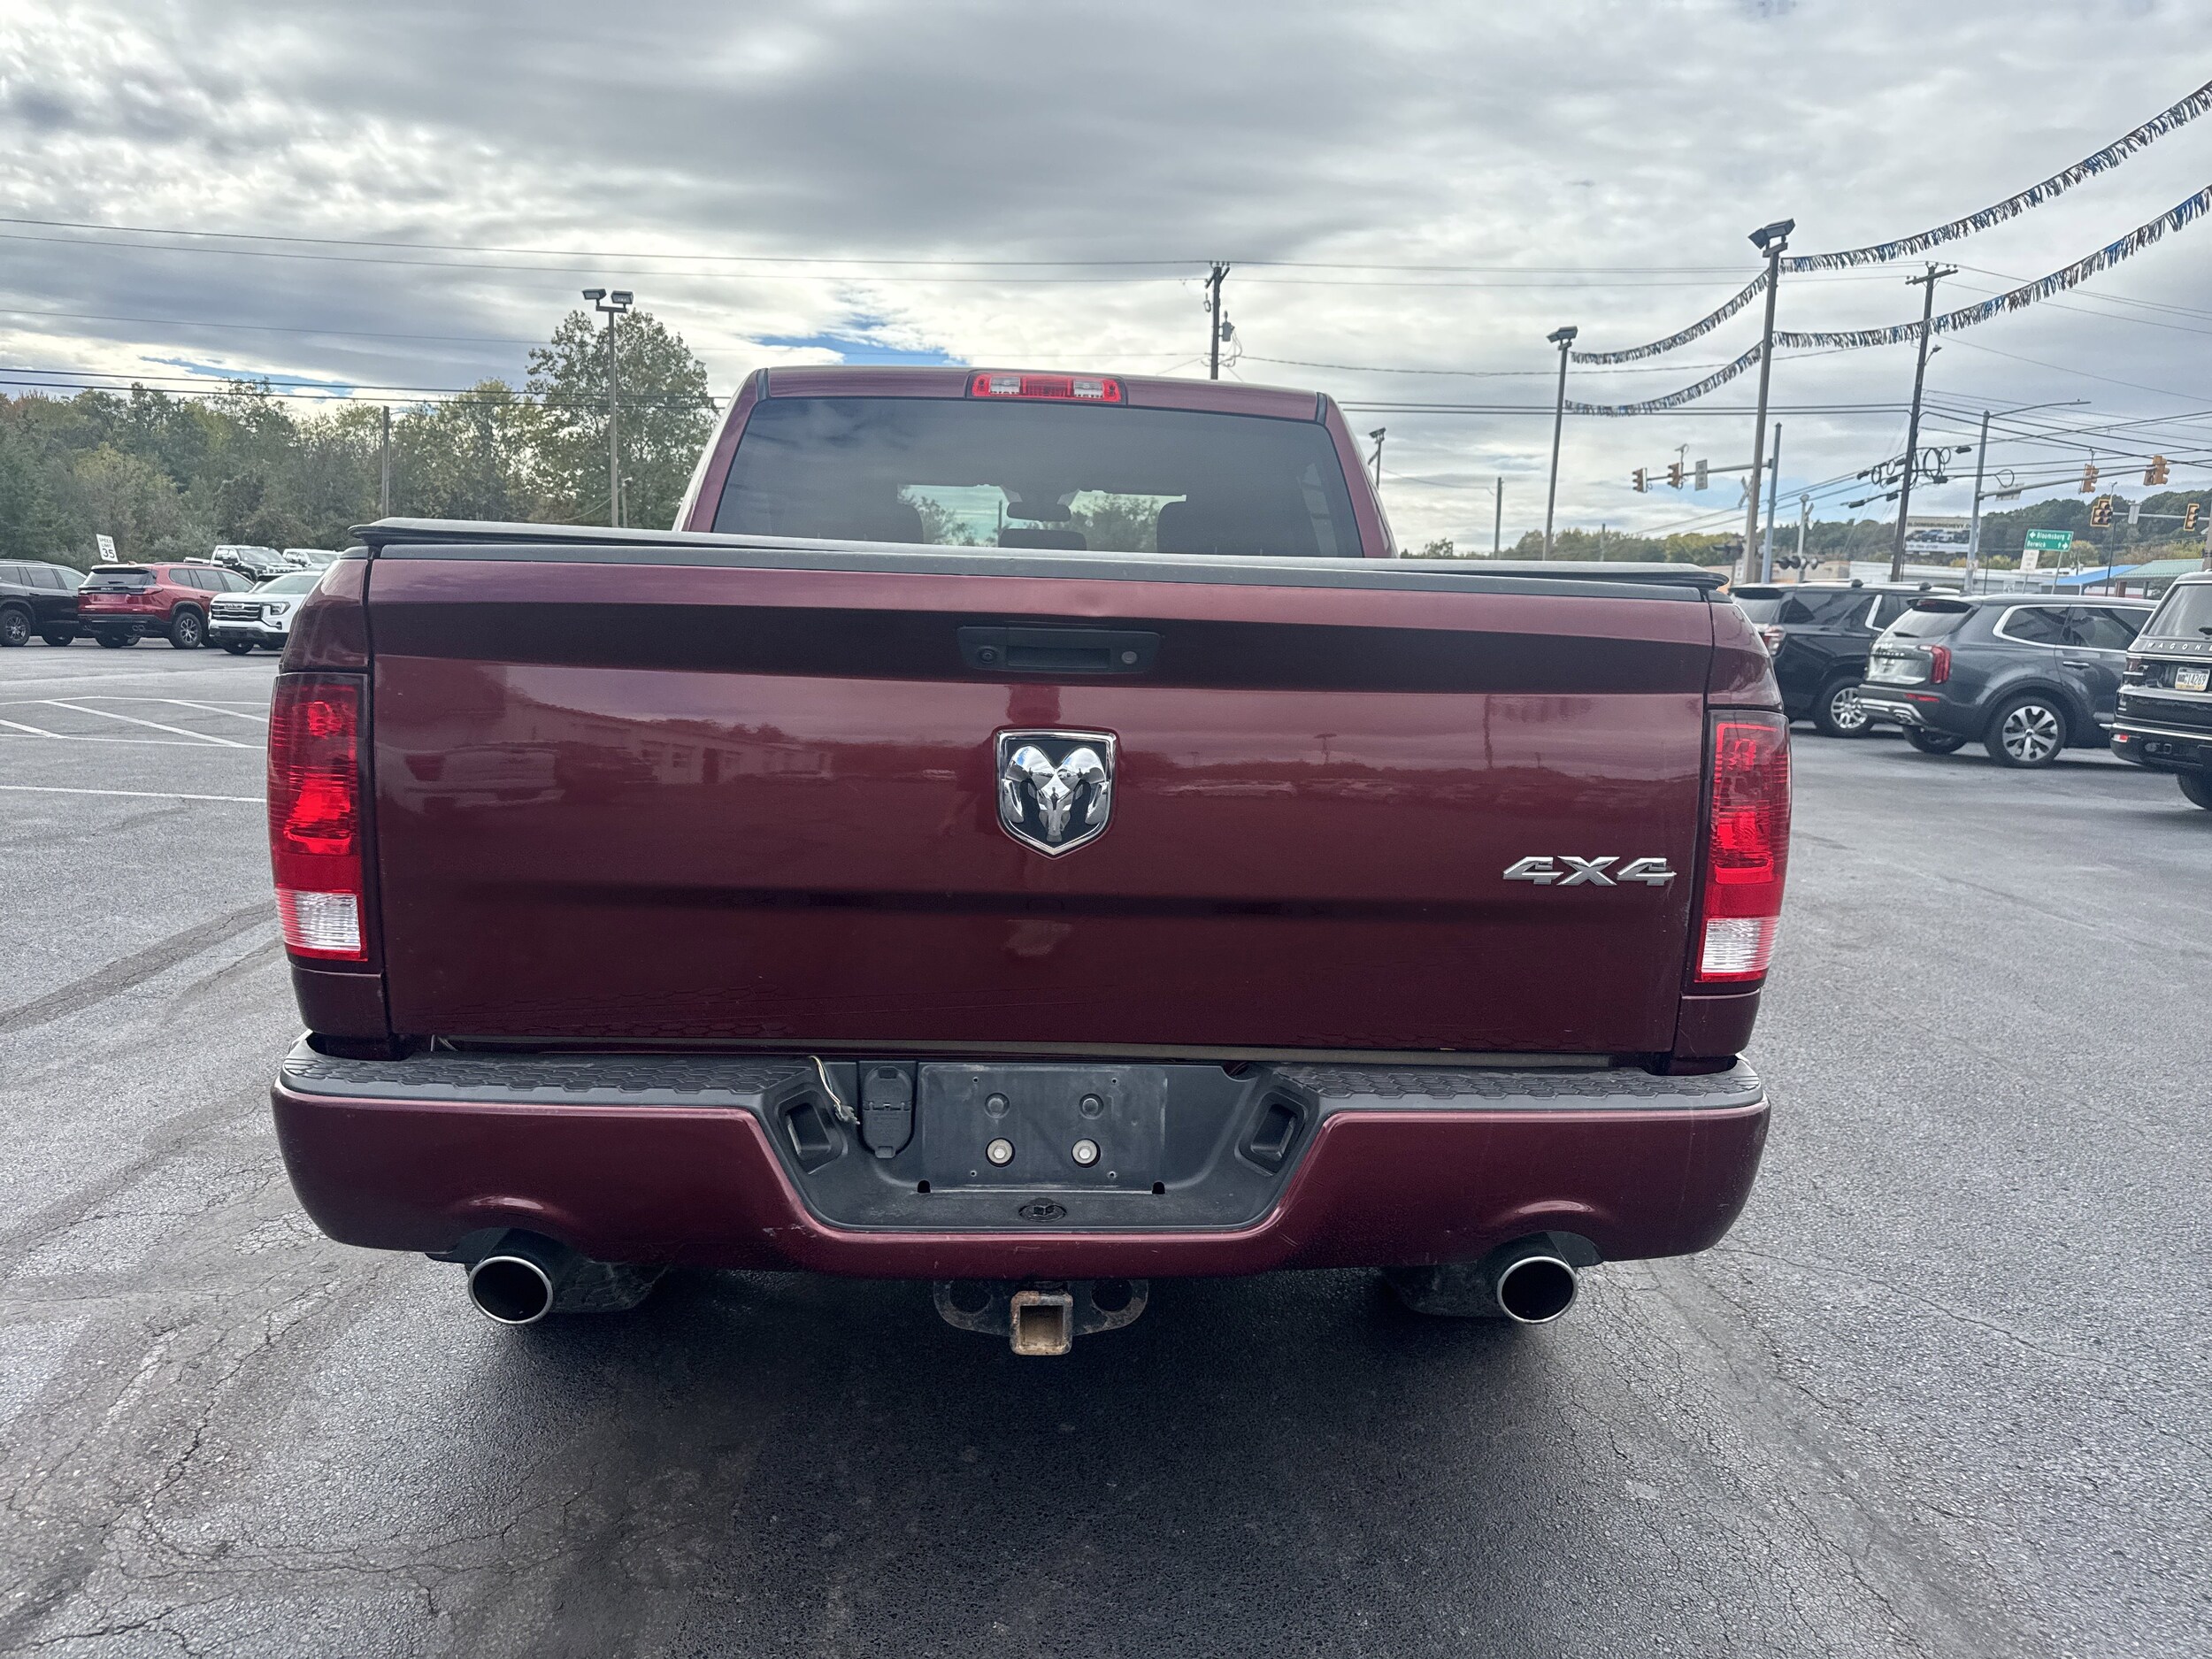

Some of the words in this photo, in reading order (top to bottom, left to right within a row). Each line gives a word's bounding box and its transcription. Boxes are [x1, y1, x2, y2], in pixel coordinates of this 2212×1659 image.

[2037, 532, 2065, 541] Bloomsburg
[103, 548, 115, 558] 35
[1503, 856, 1678, 886] 4X4
